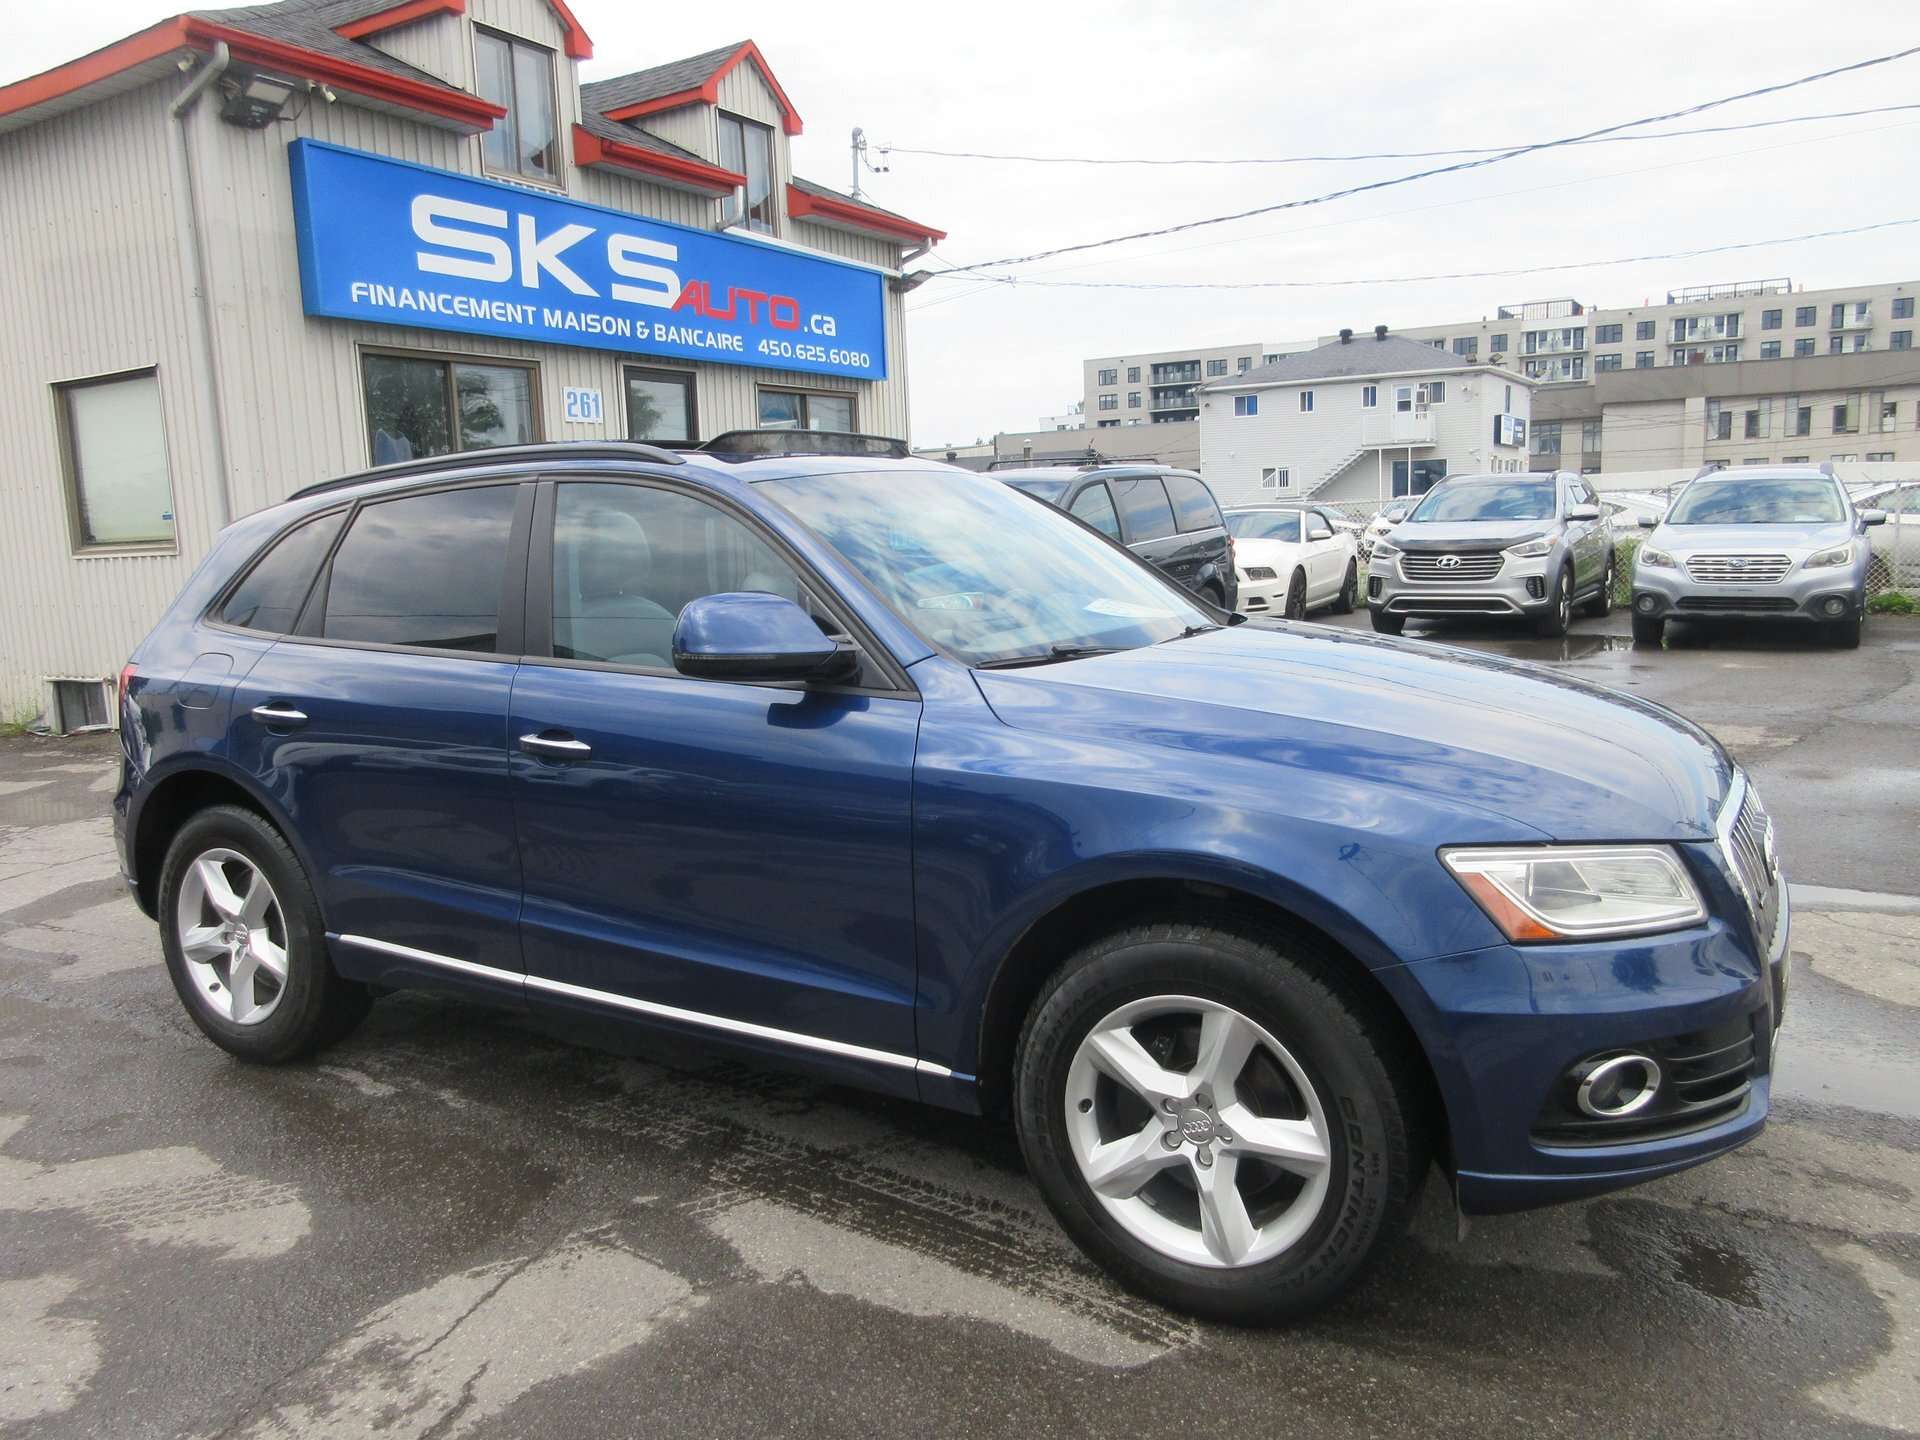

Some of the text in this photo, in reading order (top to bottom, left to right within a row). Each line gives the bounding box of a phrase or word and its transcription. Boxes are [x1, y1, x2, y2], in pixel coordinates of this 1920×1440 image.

[411, 194, 681, 309] SKS
[351, 281, 871, 368] FINANCEMENT MAISON & BANCAIRE 450.625.6080
[566, 391, 600, 418] 261
